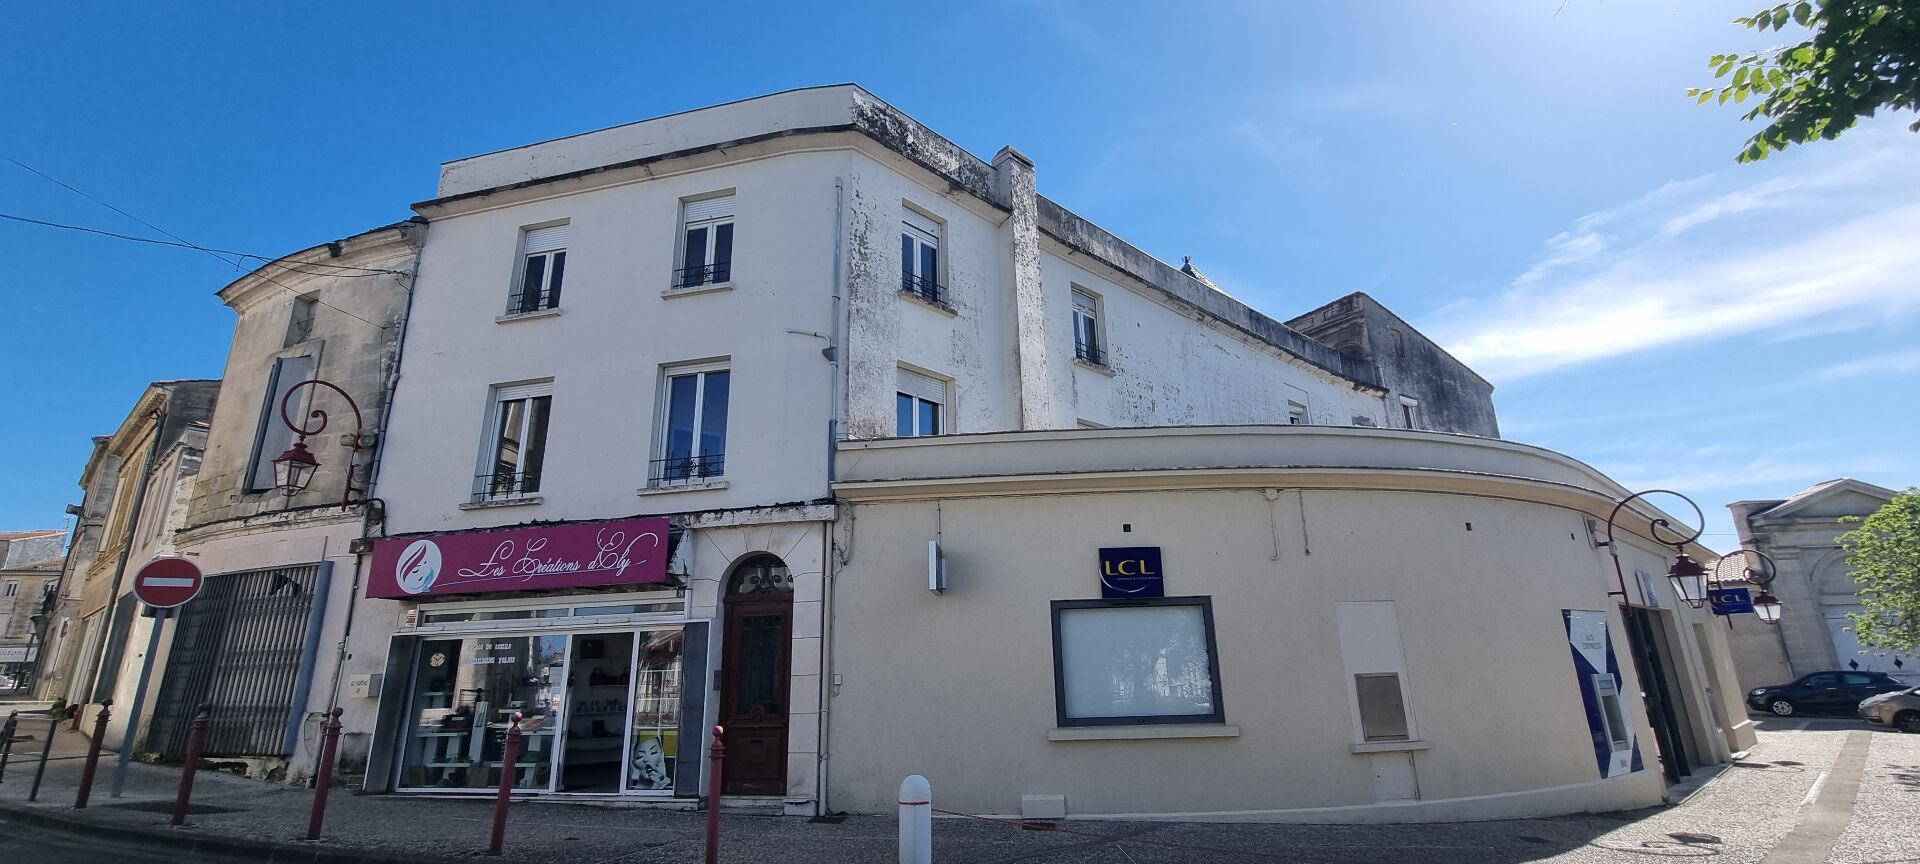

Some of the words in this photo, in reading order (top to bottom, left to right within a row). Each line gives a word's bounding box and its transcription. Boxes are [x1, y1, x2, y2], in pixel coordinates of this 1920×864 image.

[458, 540, 515, 577] Les
[512, 537, 581, 582] Créations
[1105, 559, 1155, 576] LCL
[1712, 593, 1745, 604] LCL
